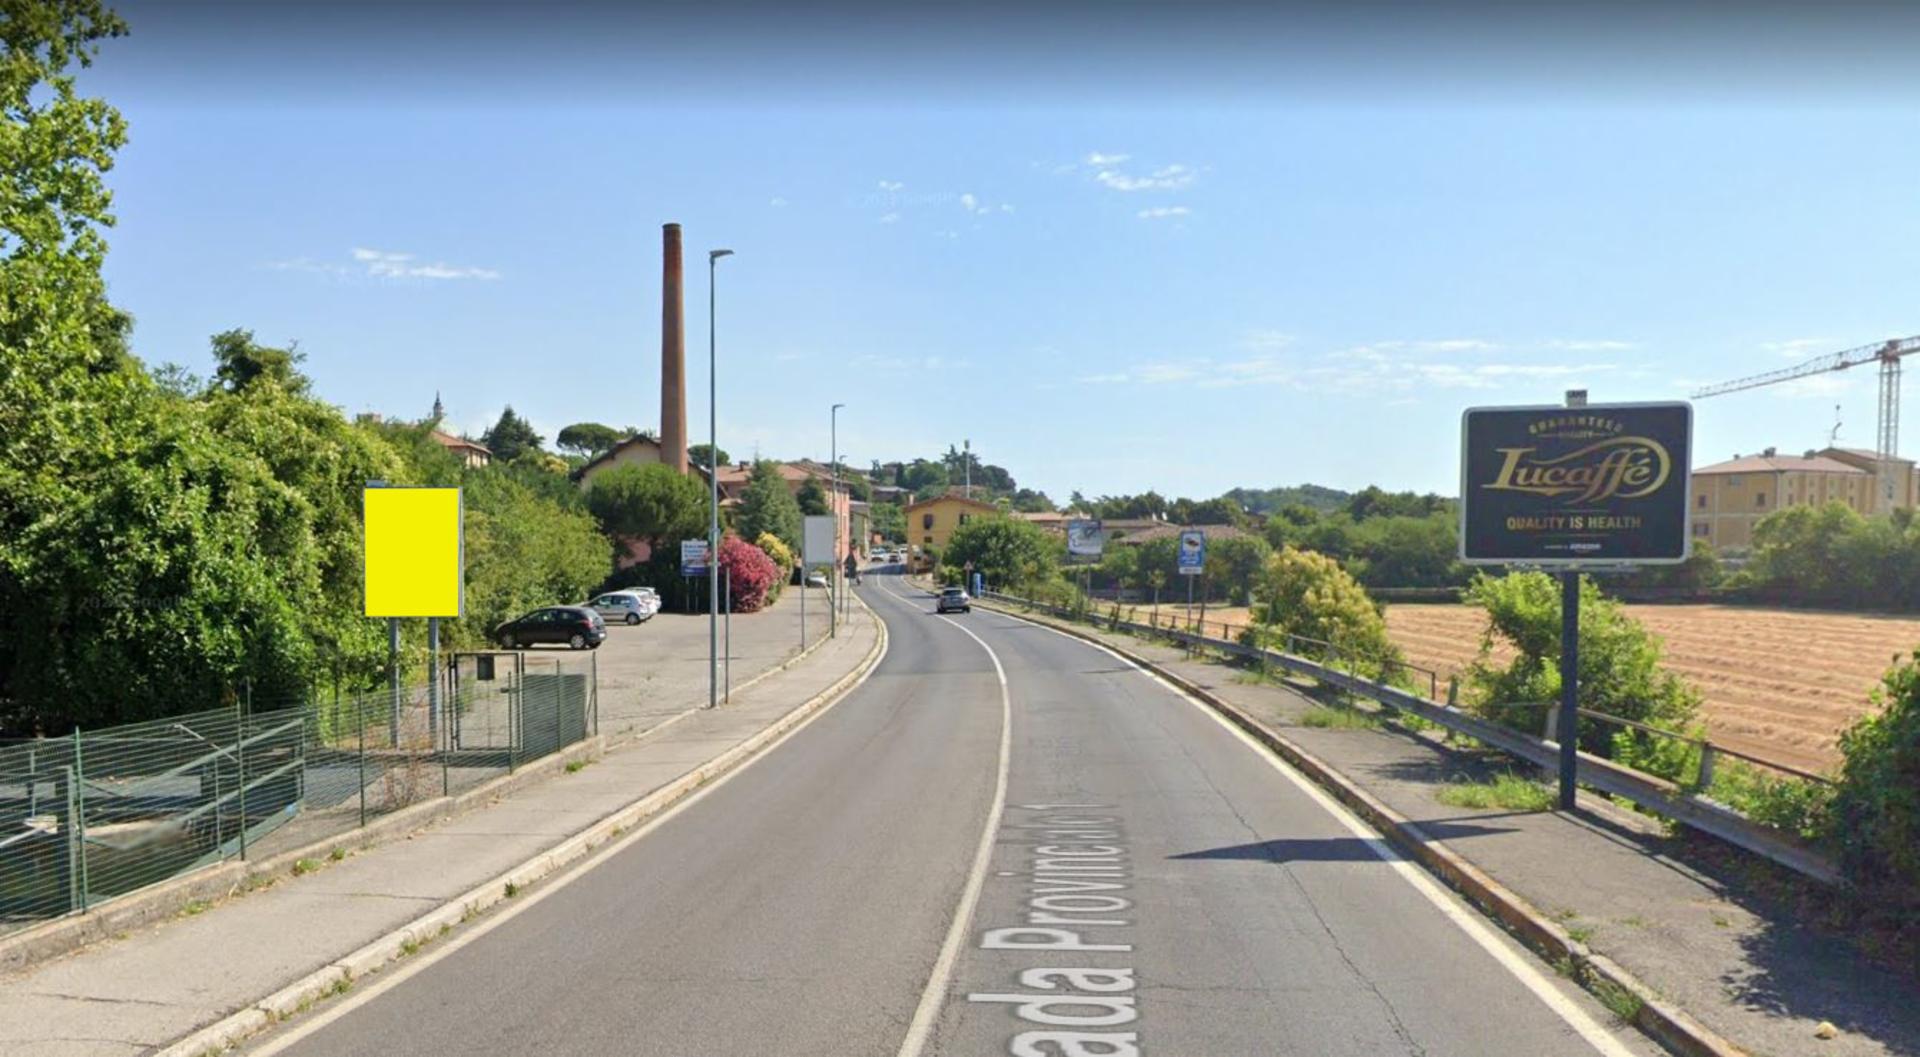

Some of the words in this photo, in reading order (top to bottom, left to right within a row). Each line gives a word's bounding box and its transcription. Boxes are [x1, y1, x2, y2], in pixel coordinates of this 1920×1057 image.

[1506, 516, 1565, 531] QUALITY
[1569, 516, 1584, 529] IS
[1588, 515, 1642, 529] HEALTH
